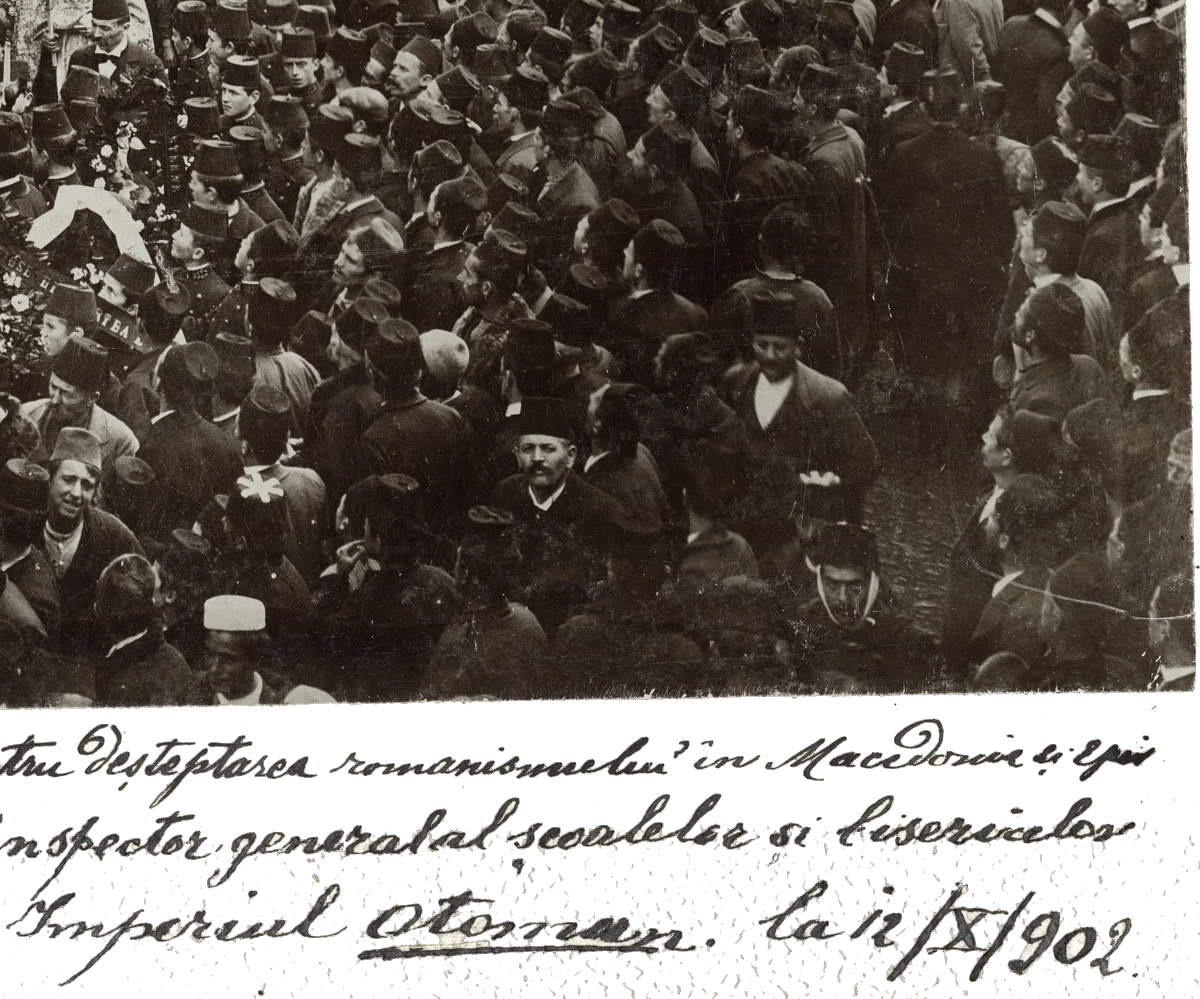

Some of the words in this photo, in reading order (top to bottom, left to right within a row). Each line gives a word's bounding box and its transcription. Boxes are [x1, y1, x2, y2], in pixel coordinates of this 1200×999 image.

[208, 809, 447, 888] general
[429, 798, 520, 850] al
[6, 884, 347, 987] Imperiul
[759, 880, 845, 939] la
